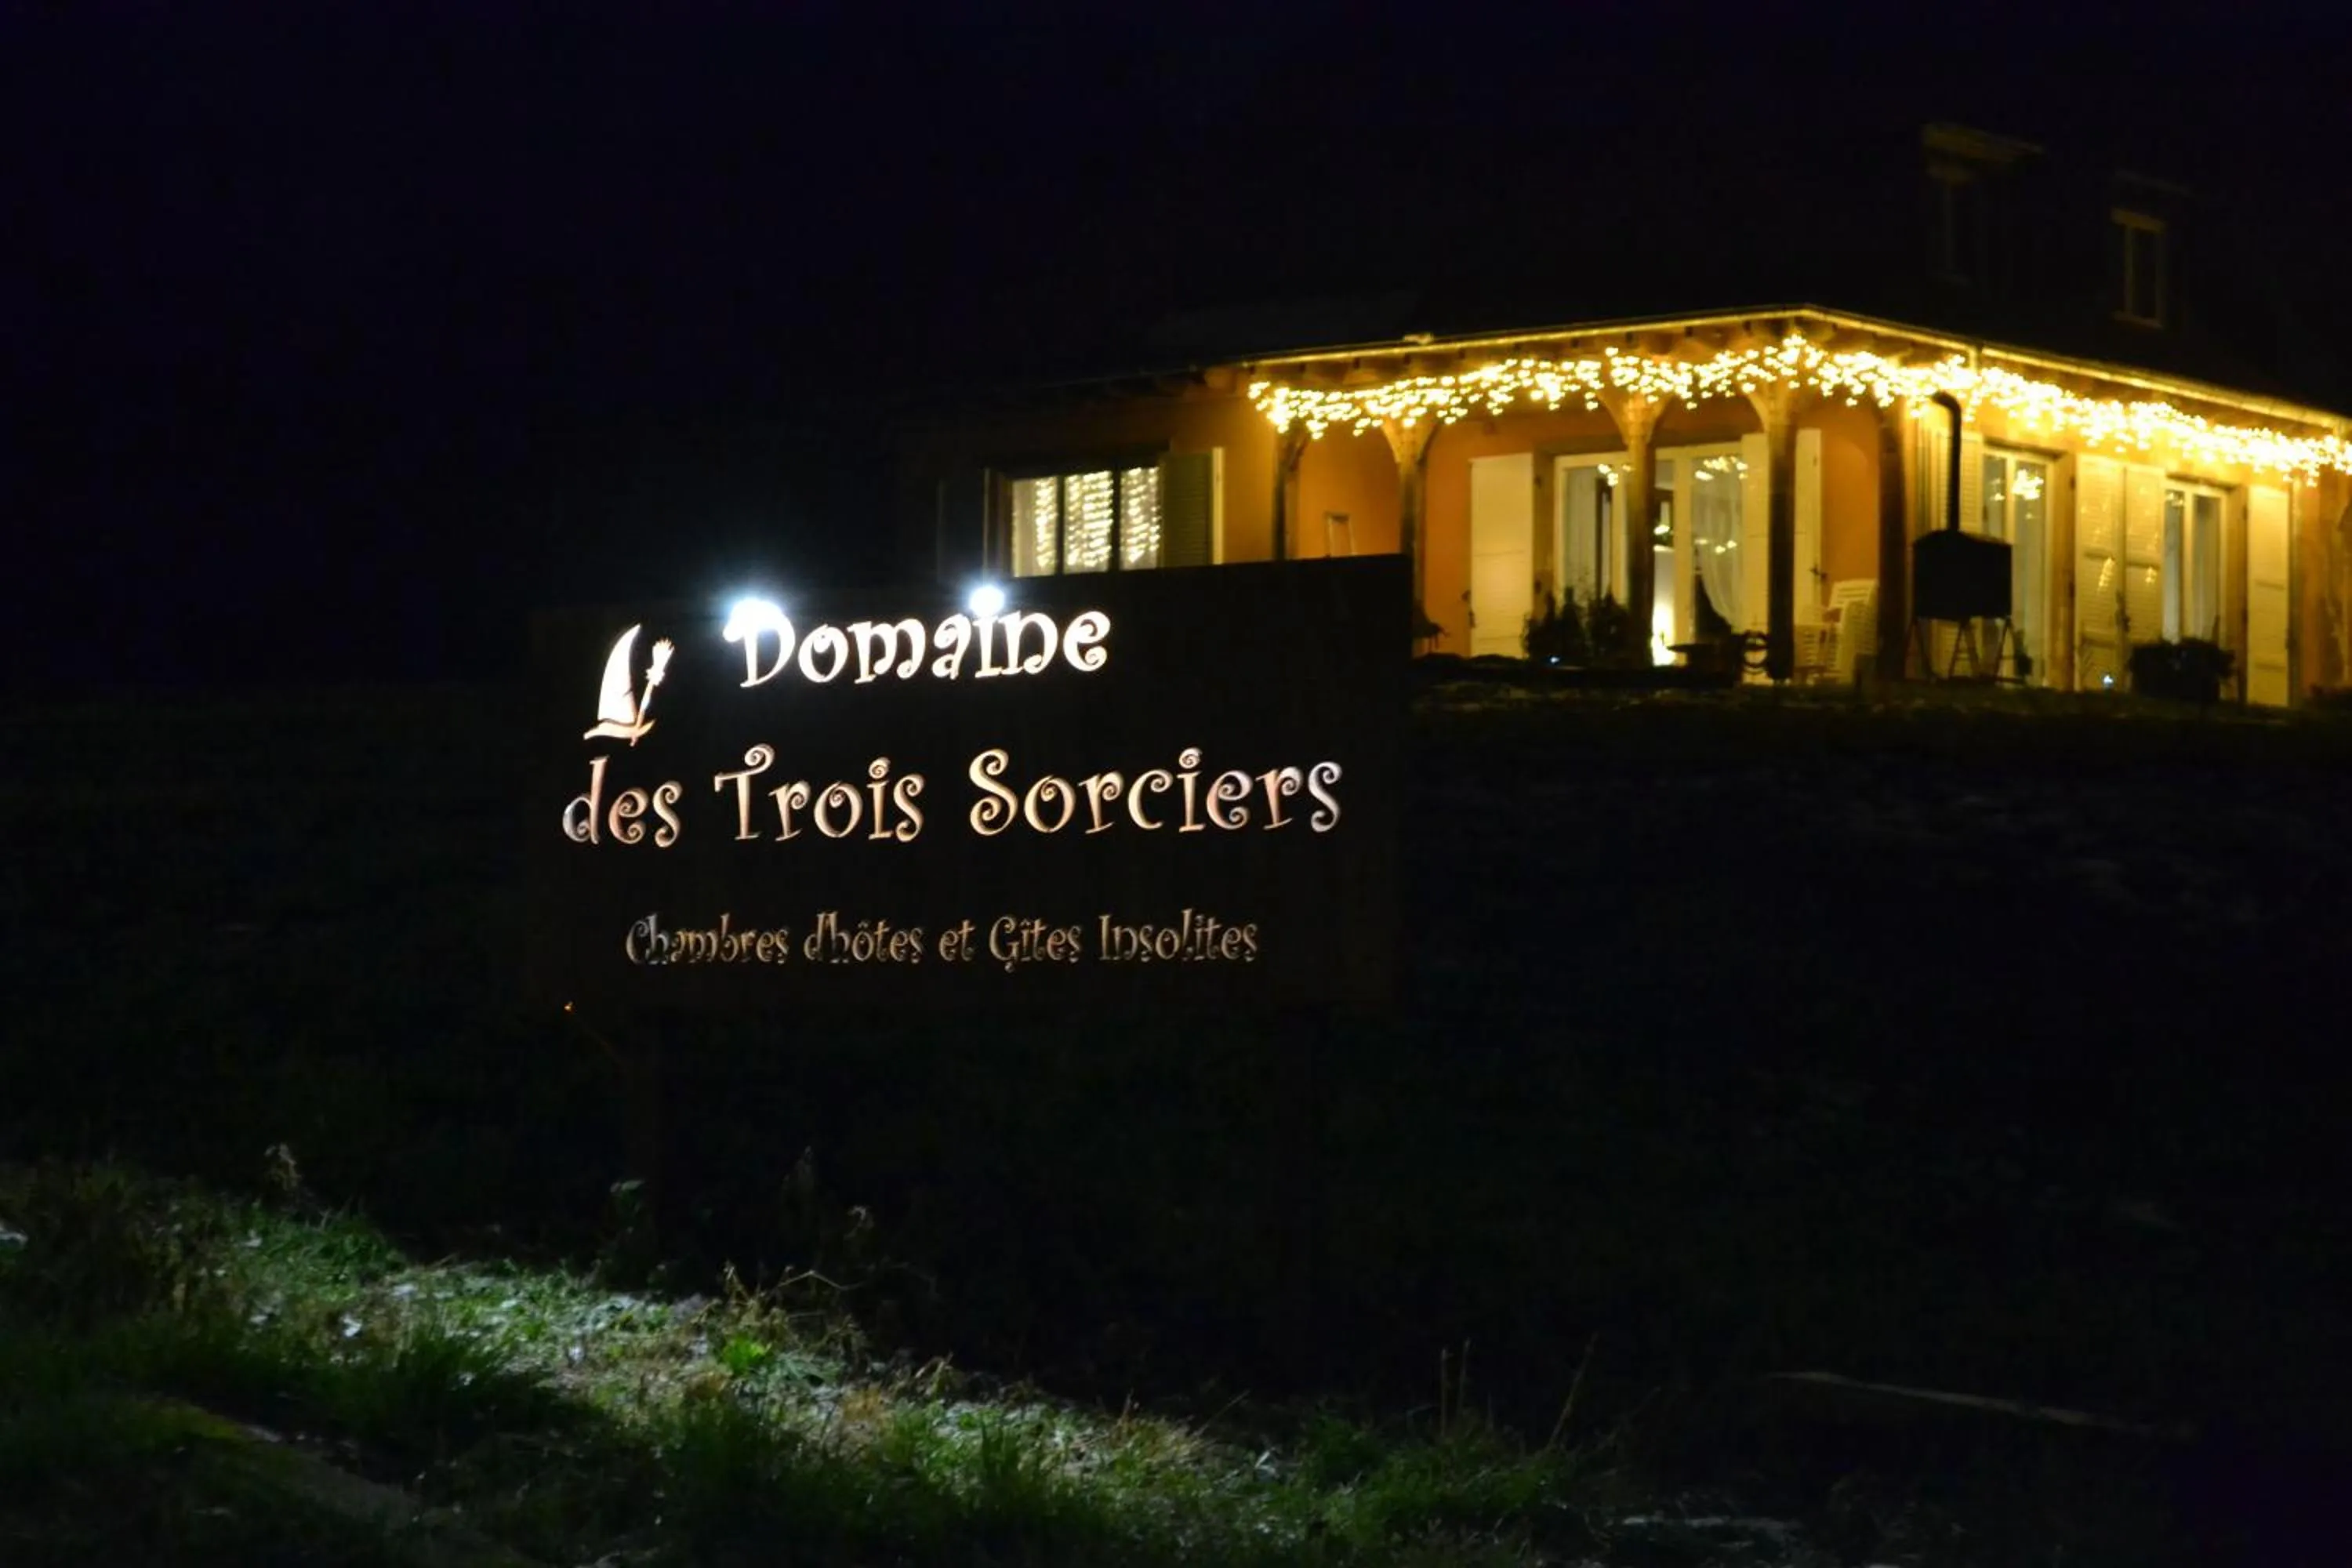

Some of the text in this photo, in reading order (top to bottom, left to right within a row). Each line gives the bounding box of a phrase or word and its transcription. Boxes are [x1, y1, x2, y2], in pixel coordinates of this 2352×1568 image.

[723, 592, 1110, 688] Domaine
[562, 743, 1341, 848] des Trois Sorciers
[626, 908, 1258, 973] Chambres d'hôtes et Gîtes Insolites
